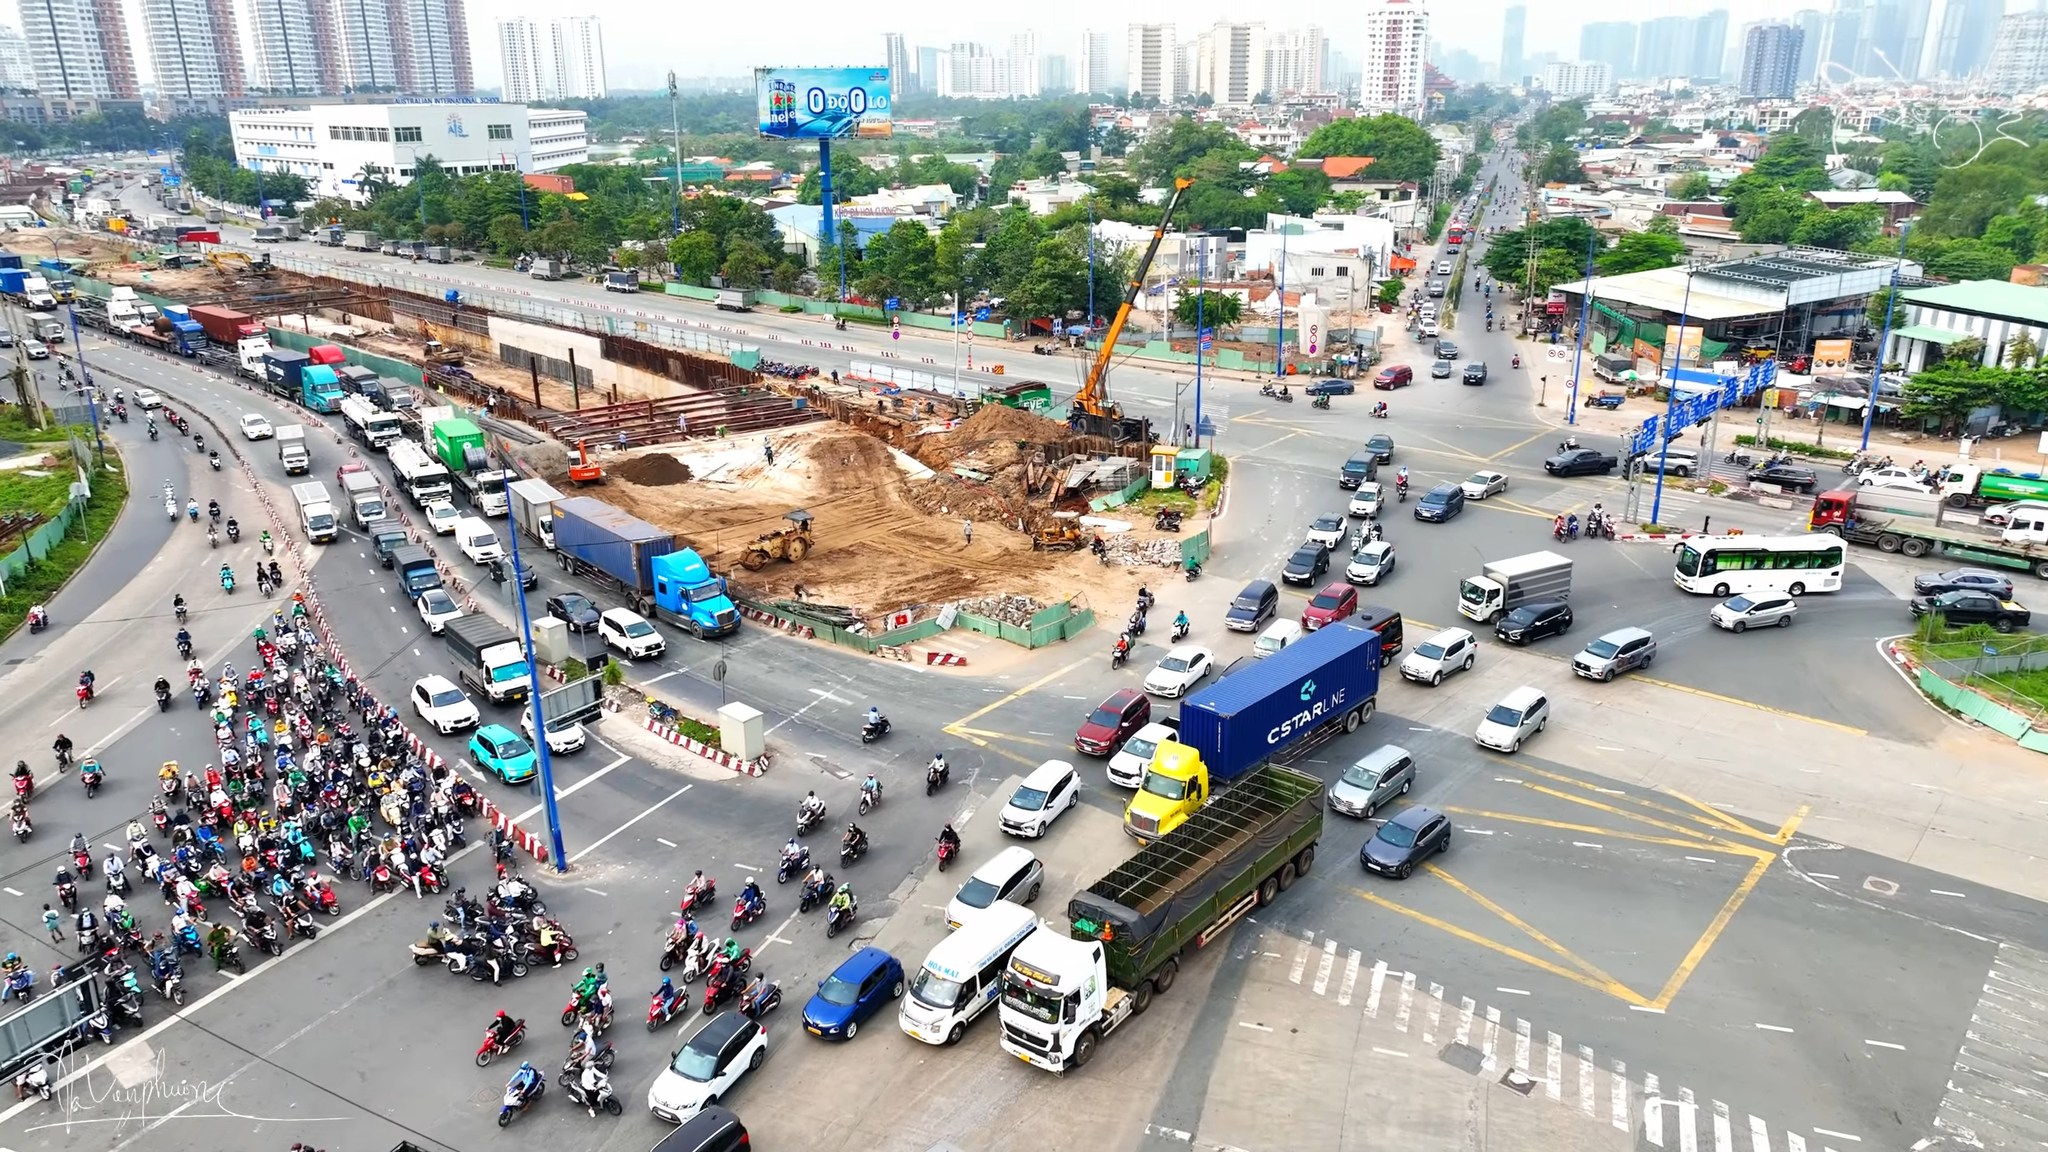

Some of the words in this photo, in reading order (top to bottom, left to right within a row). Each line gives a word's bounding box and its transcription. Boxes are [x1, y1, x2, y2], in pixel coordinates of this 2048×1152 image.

[394, 97, 433, 105] AUSTRALIAN
[434, 97, 479, 105] INTERNATIONAL
[927, 960, 943, 973] HOA
[943, 967, 961, 980] MAI
